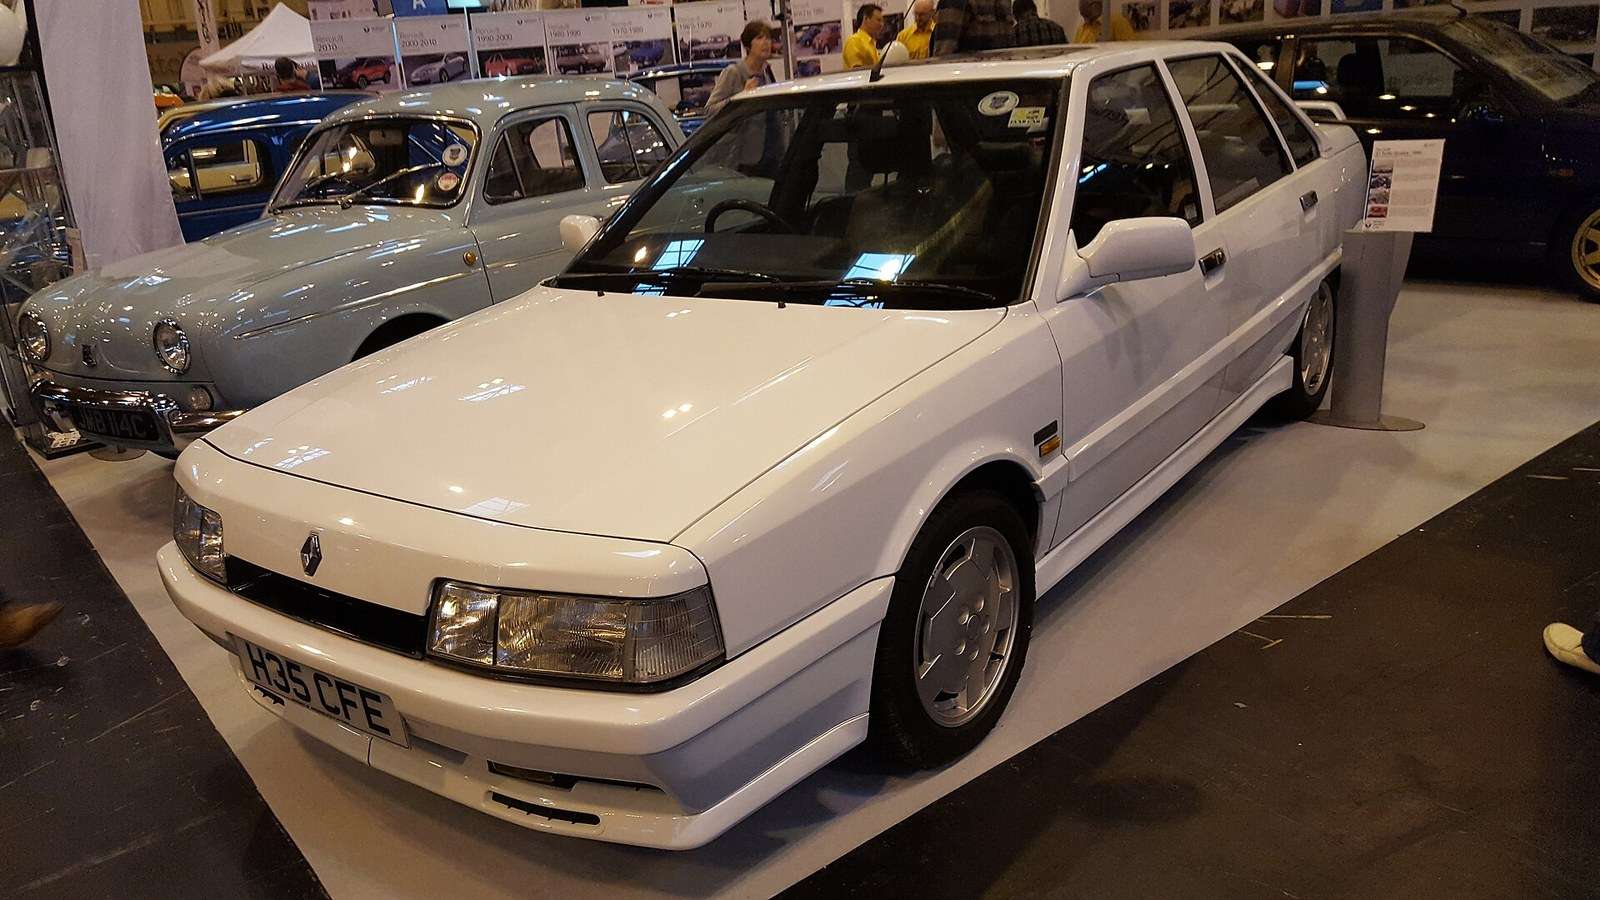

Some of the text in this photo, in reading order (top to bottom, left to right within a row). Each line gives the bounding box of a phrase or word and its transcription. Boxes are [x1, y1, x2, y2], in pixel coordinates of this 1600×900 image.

[318, 43, 338, 52] 2010
[245, 642, 391, 736] H35 CFE
